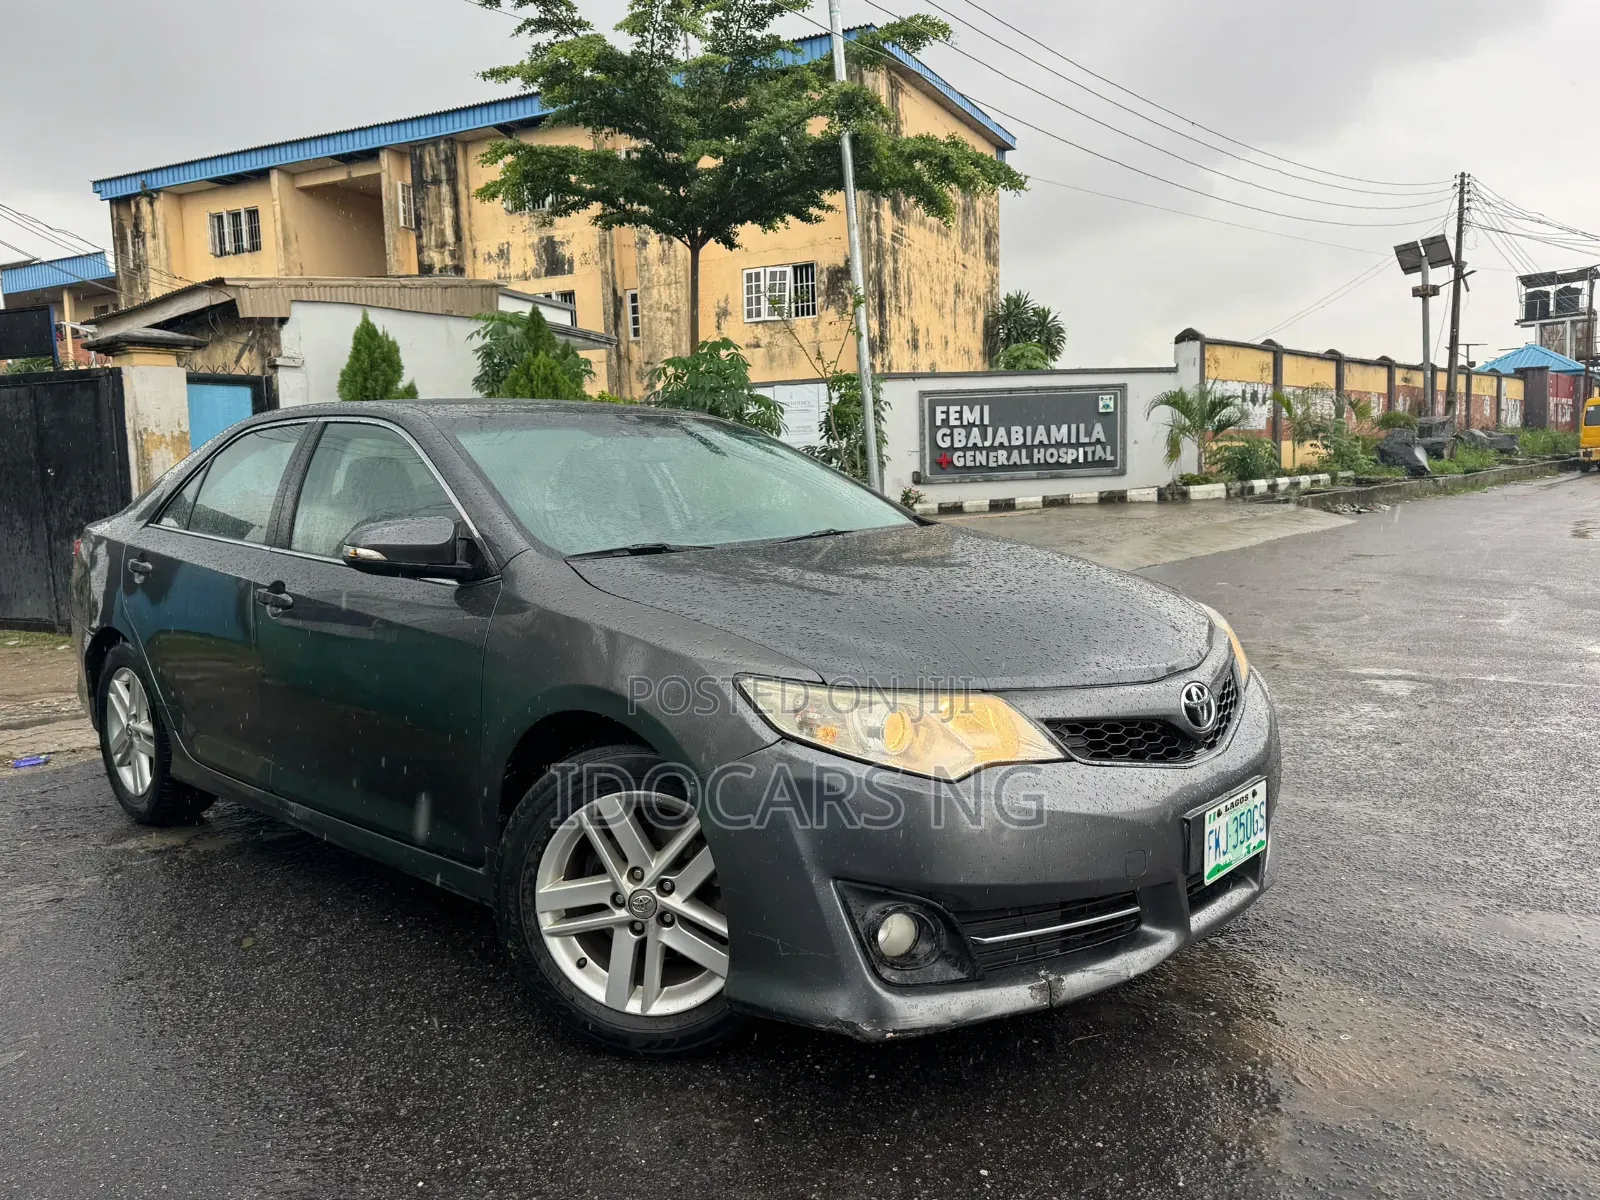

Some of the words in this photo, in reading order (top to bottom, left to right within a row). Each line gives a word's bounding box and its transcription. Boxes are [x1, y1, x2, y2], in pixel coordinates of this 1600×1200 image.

[935, 405, 990, 426] FEMI
[935, 422, 1106, 448] GBAJABIAMILA
[952, 448, 1030, 468] GENERAL
[1033, 445, 1115, 465] HOSPITAL
[1224, 793, 1249, 813] LAGOS
